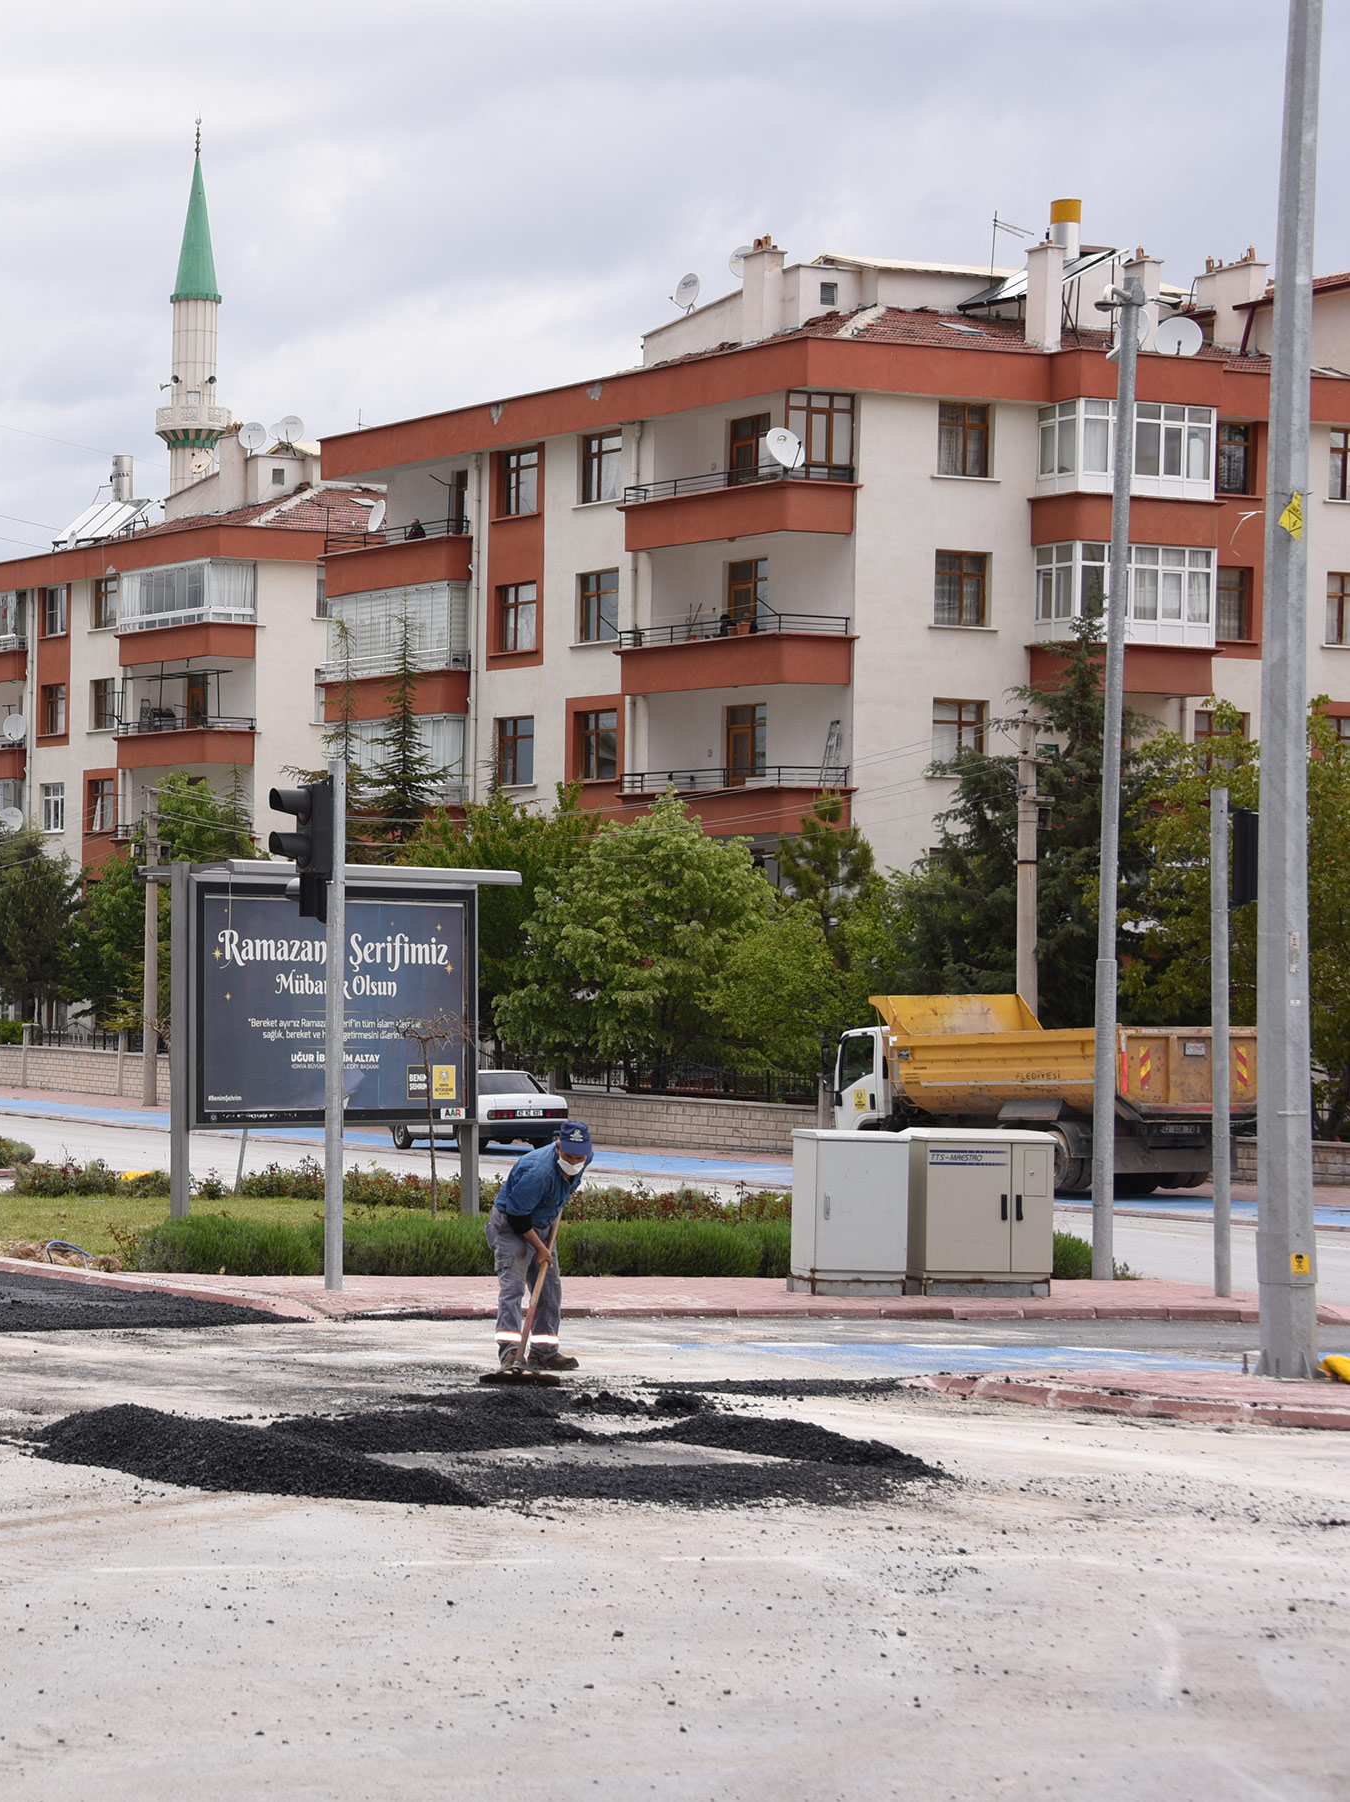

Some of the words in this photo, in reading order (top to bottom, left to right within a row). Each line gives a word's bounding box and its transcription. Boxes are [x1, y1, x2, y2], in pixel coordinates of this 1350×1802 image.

[349, 933, 448, 972] Şerifimiz
[352, 974, 397, 998] Olsun
[286, 1030, 311, 1039] bereket
[291, 1051, 314, 1062] UĞUR
[354, 1054, 380, 1063] ALTAY
